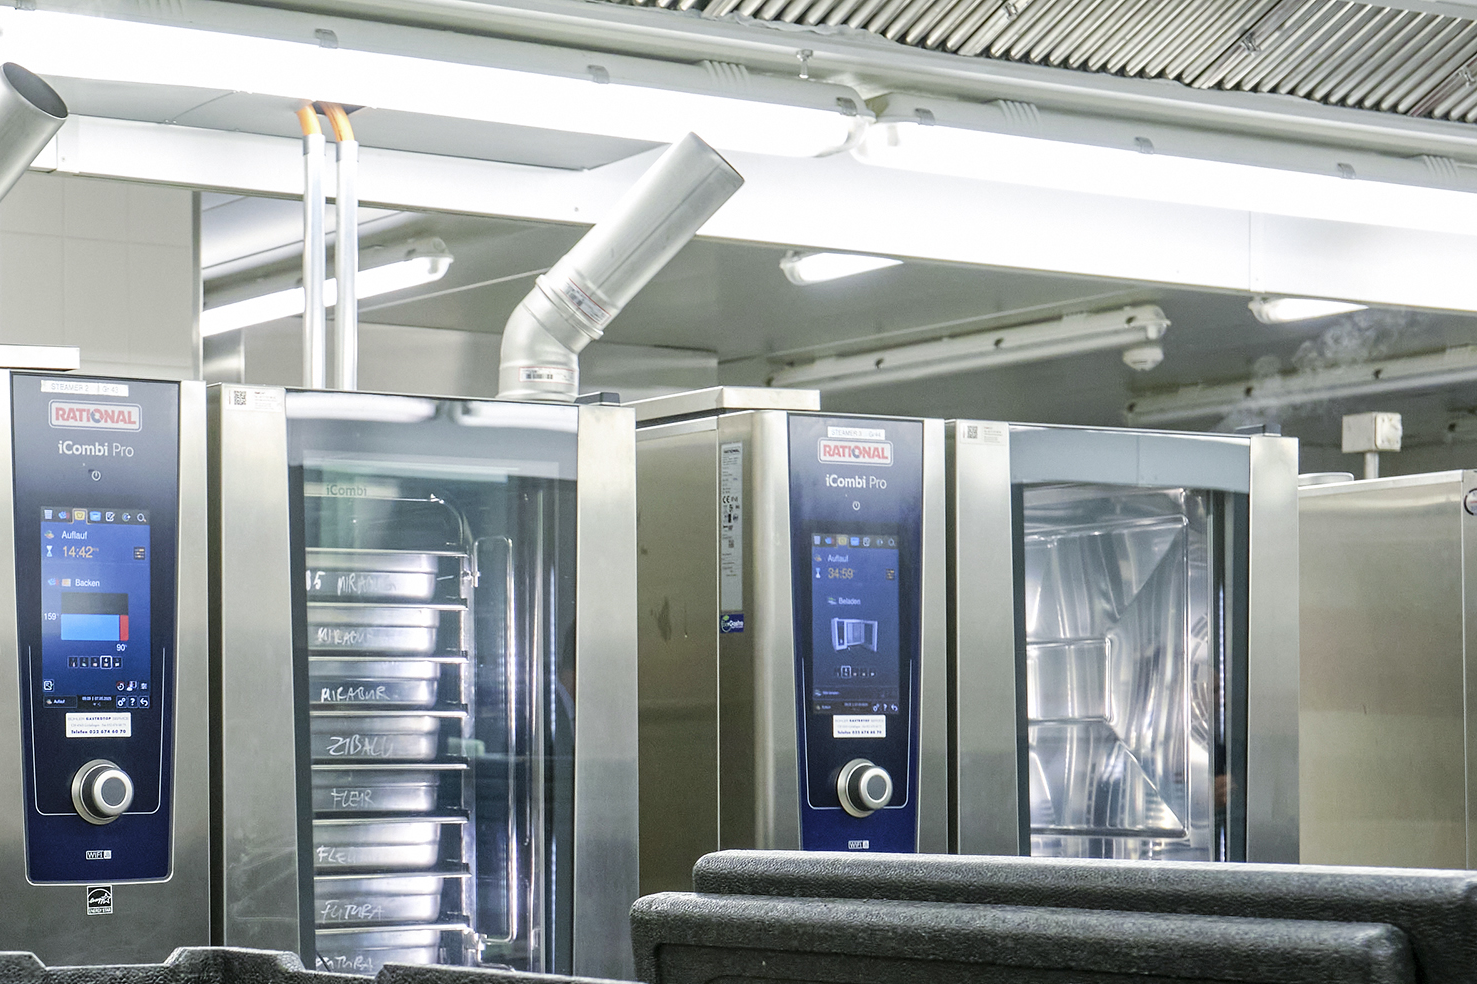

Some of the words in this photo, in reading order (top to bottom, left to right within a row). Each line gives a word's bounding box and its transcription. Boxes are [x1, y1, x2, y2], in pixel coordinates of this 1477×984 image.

[55, 407, 136, 425] RATIONAL
[58, 441, 108, 456] iCombi
[112, 443, 134, 457] Pro
[823, 444, 889, 460] RATIONAL
[825, 474, 866, 488] iCombi
[869, 477, 887, 489] Pro
[326, 483, 367, 496] iCombi
[61, 530, 88, 540] Auflauf
[75, 579, 100, 587] Backen
